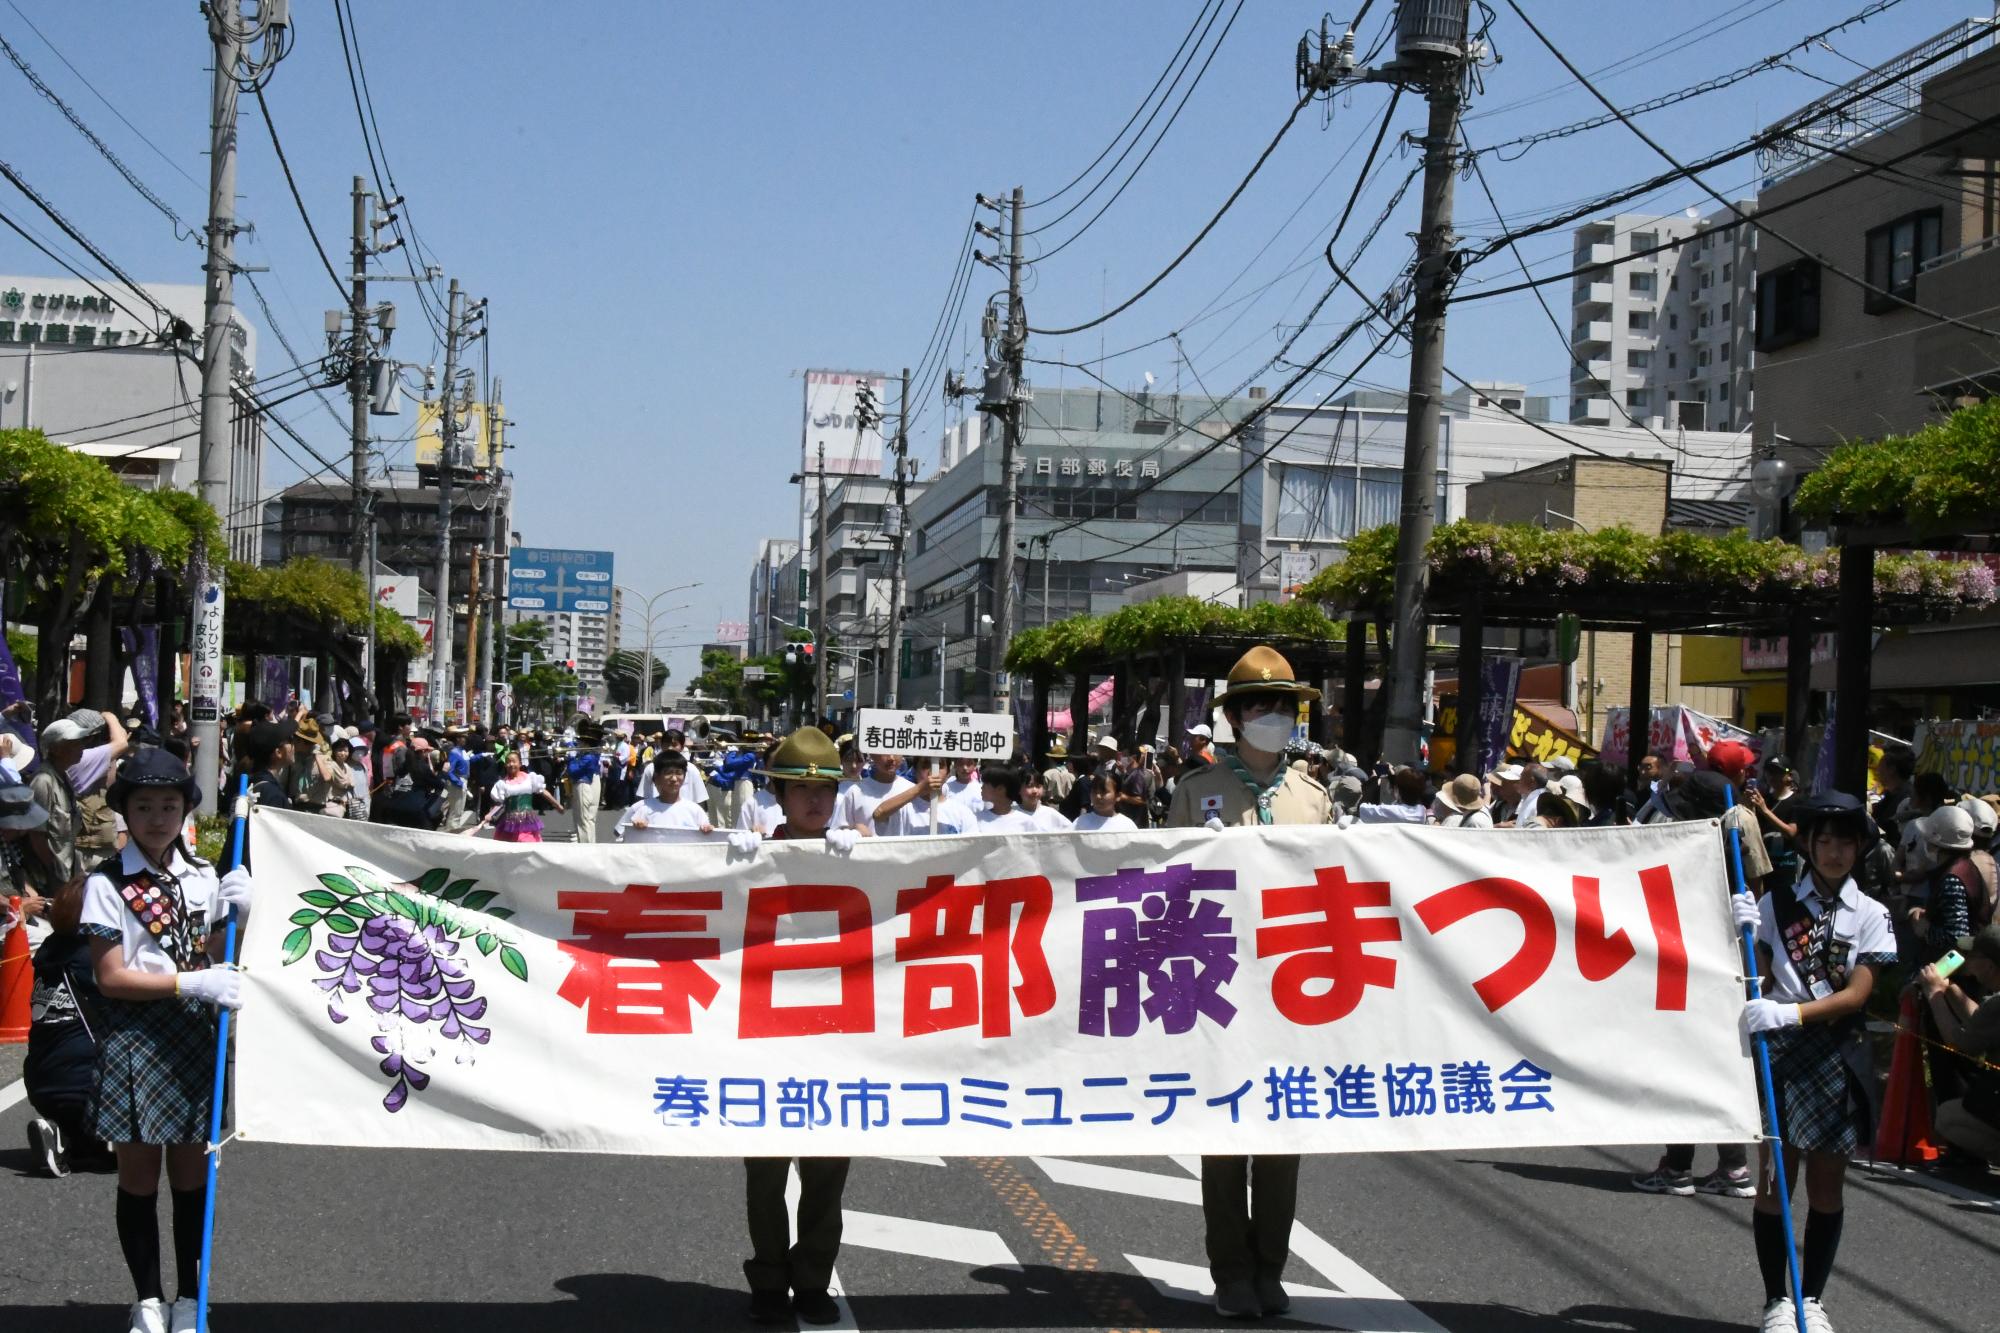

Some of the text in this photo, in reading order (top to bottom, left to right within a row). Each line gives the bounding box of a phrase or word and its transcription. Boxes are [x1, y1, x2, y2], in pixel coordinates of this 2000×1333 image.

[208, 605, 220, 660] よしひろ
[864, 726, 1006, 754] 春日部市立春日部中
[903, 714, 970, 728] 埼玉県
[556, 863, 1689, 1039] 春日部藤まつり
[653, 1059, 1556, 1131] 春日部市コミュニティ推進協議会
